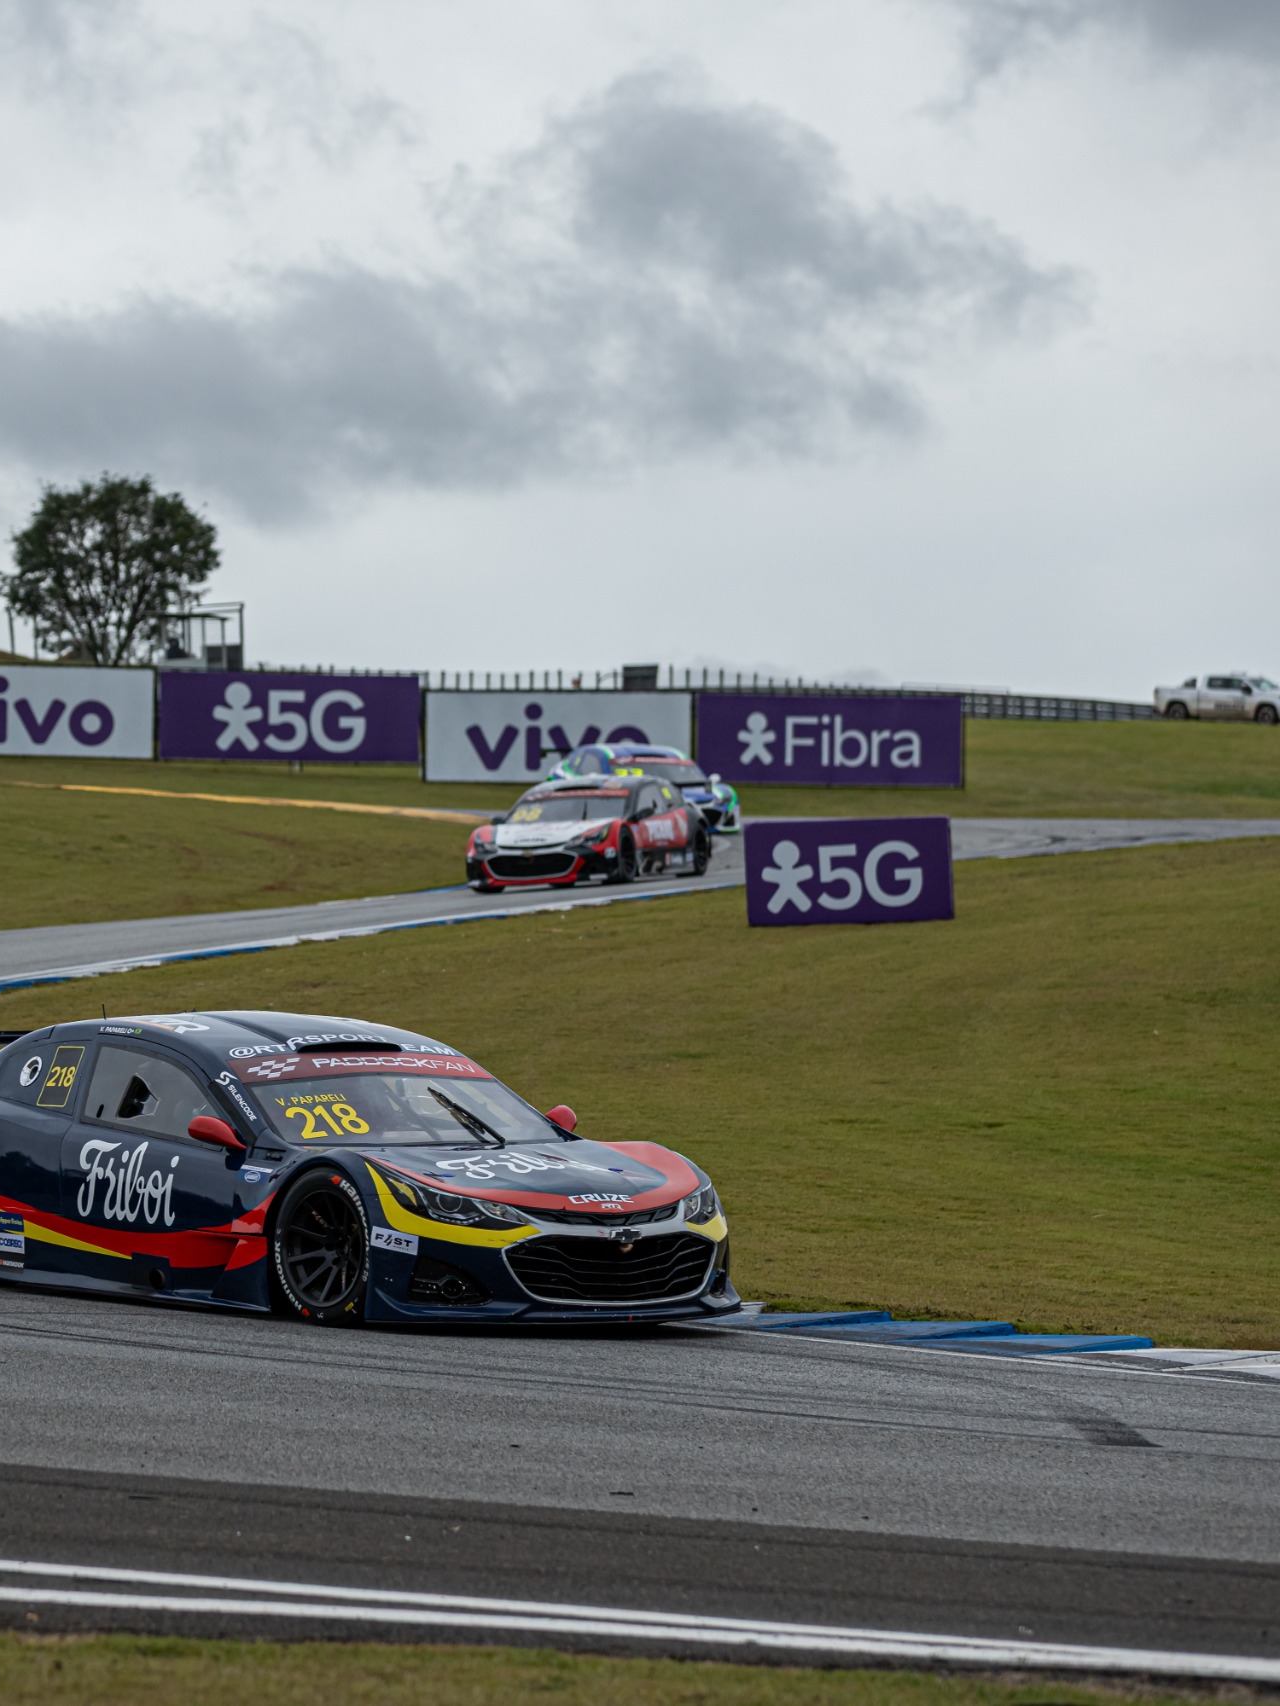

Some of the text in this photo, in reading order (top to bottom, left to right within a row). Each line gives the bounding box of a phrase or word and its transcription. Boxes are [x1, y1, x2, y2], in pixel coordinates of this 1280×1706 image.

[264, 690, 367, 753] 5G
[784, 714, 922, 768] Fibra
[817, 840, 923, 911] 5G
[46, 1066, 76, 1087] 218
[228, 1084, 257, 1121] SILENCODE
[275, 1093, 346, 1107] V. PAPARELI
[285, 1103, 370, 1140] 218
[568, 1193, 635, 1204] CRUZE
